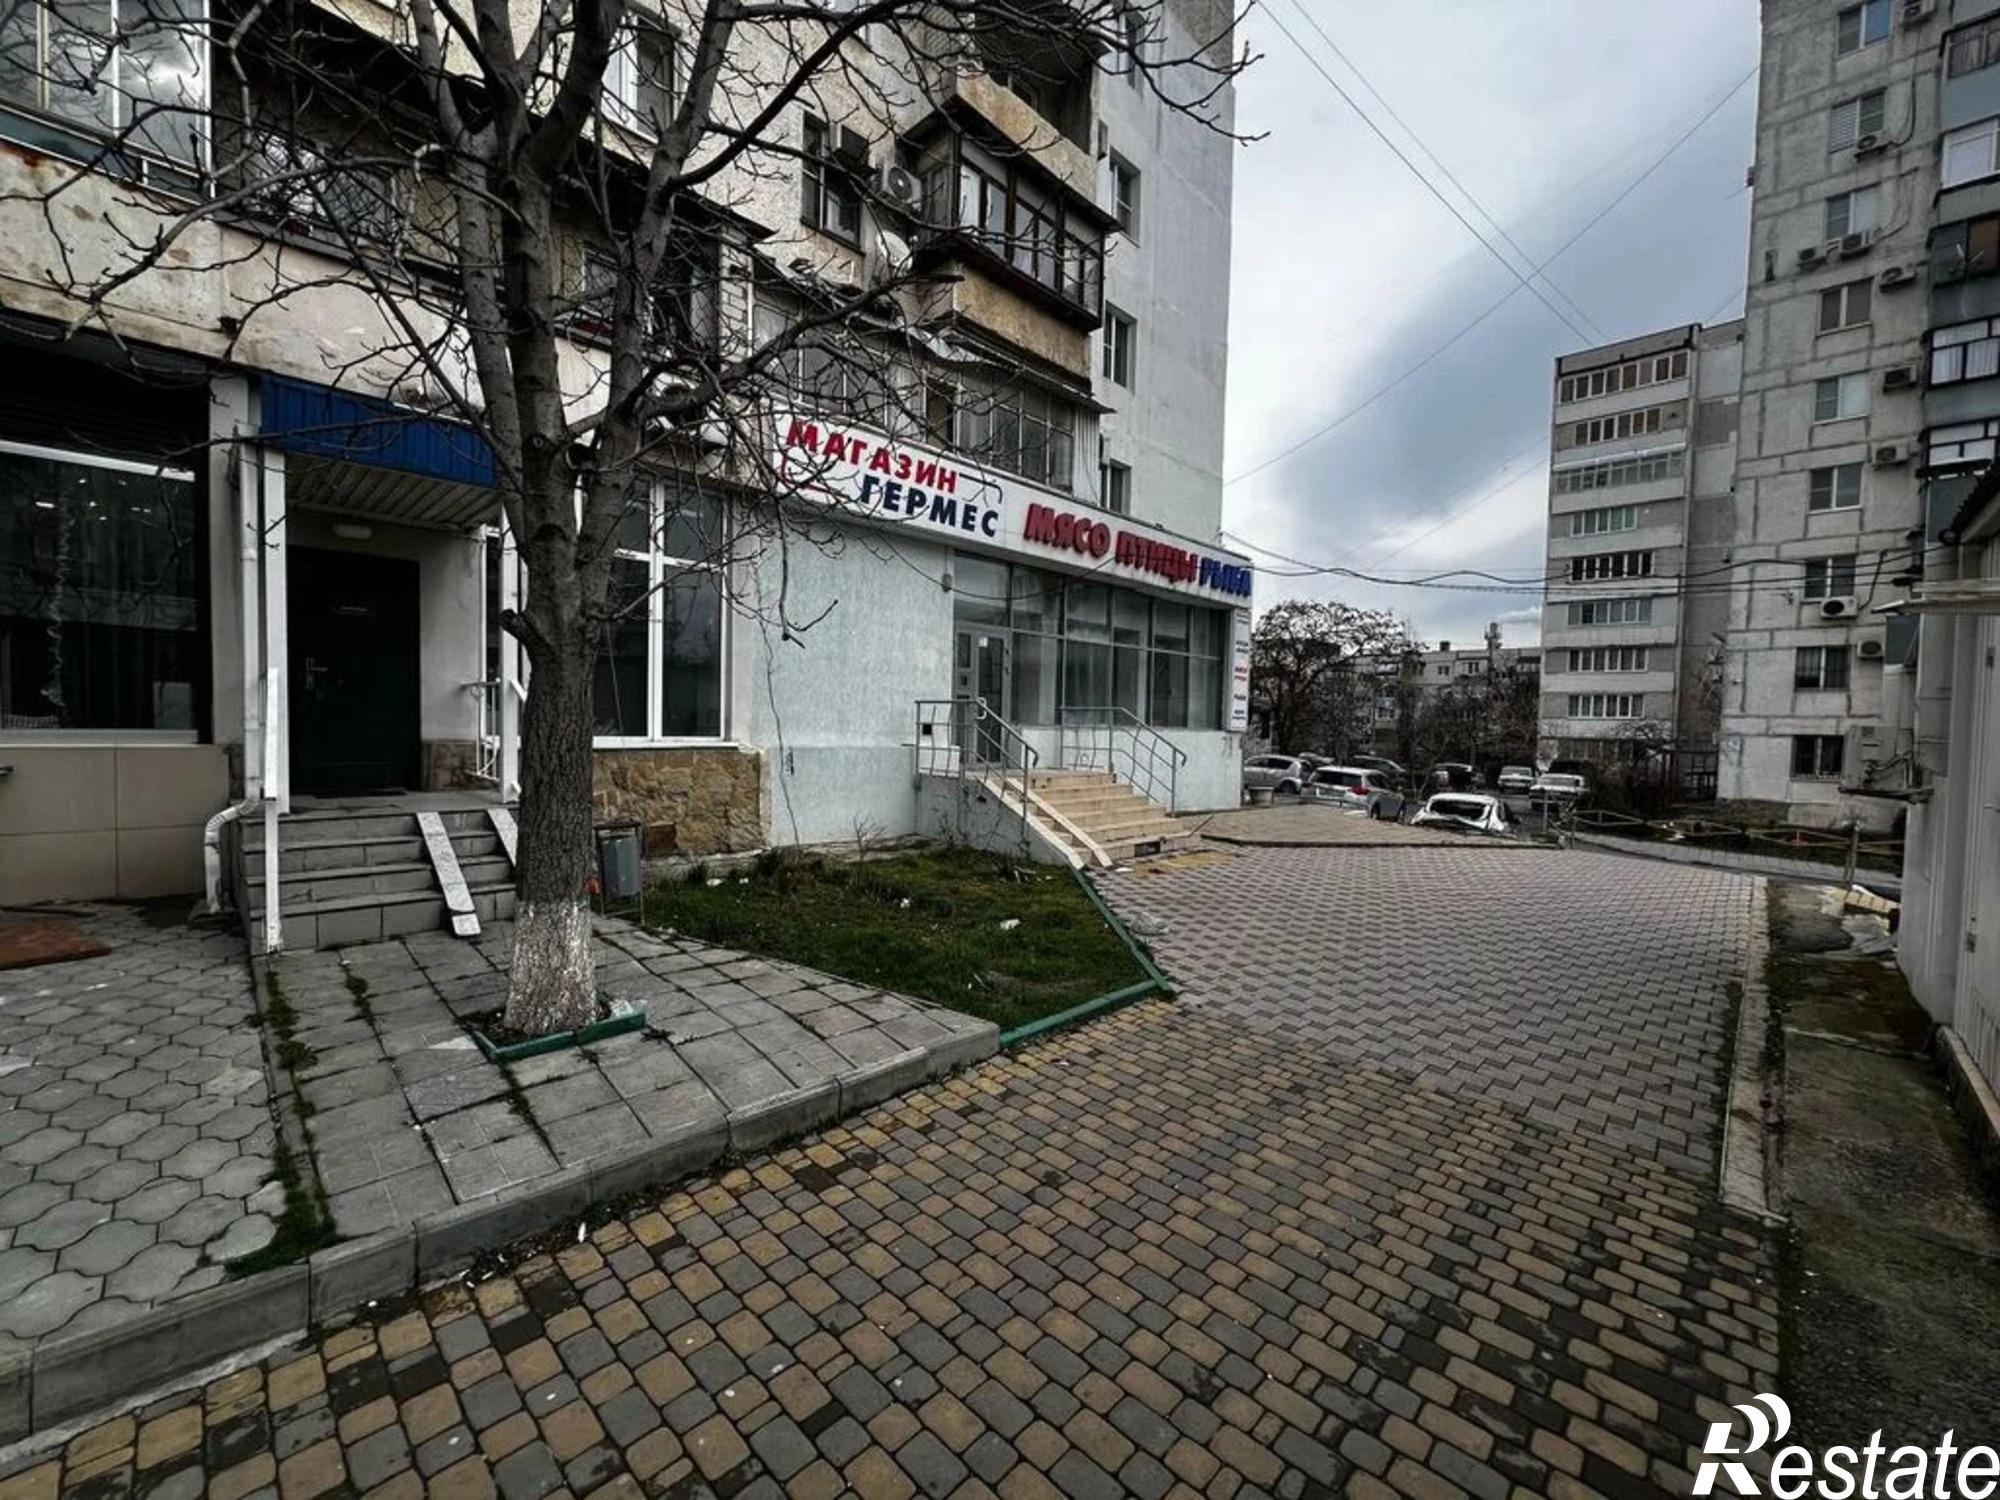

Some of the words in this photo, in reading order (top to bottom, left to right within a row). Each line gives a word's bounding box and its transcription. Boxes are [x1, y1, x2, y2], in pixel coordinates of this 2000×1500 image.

[786, 418, 959, 494] МАГАЗИН
[860, 473, 999, 537] ГЕРМЕС
[1023, 503, 1111, 558] МЯСО
[1115, 530, 1199, 584] ПТИЦЫ
[1199, 556, 1251, 598] РЫБА
